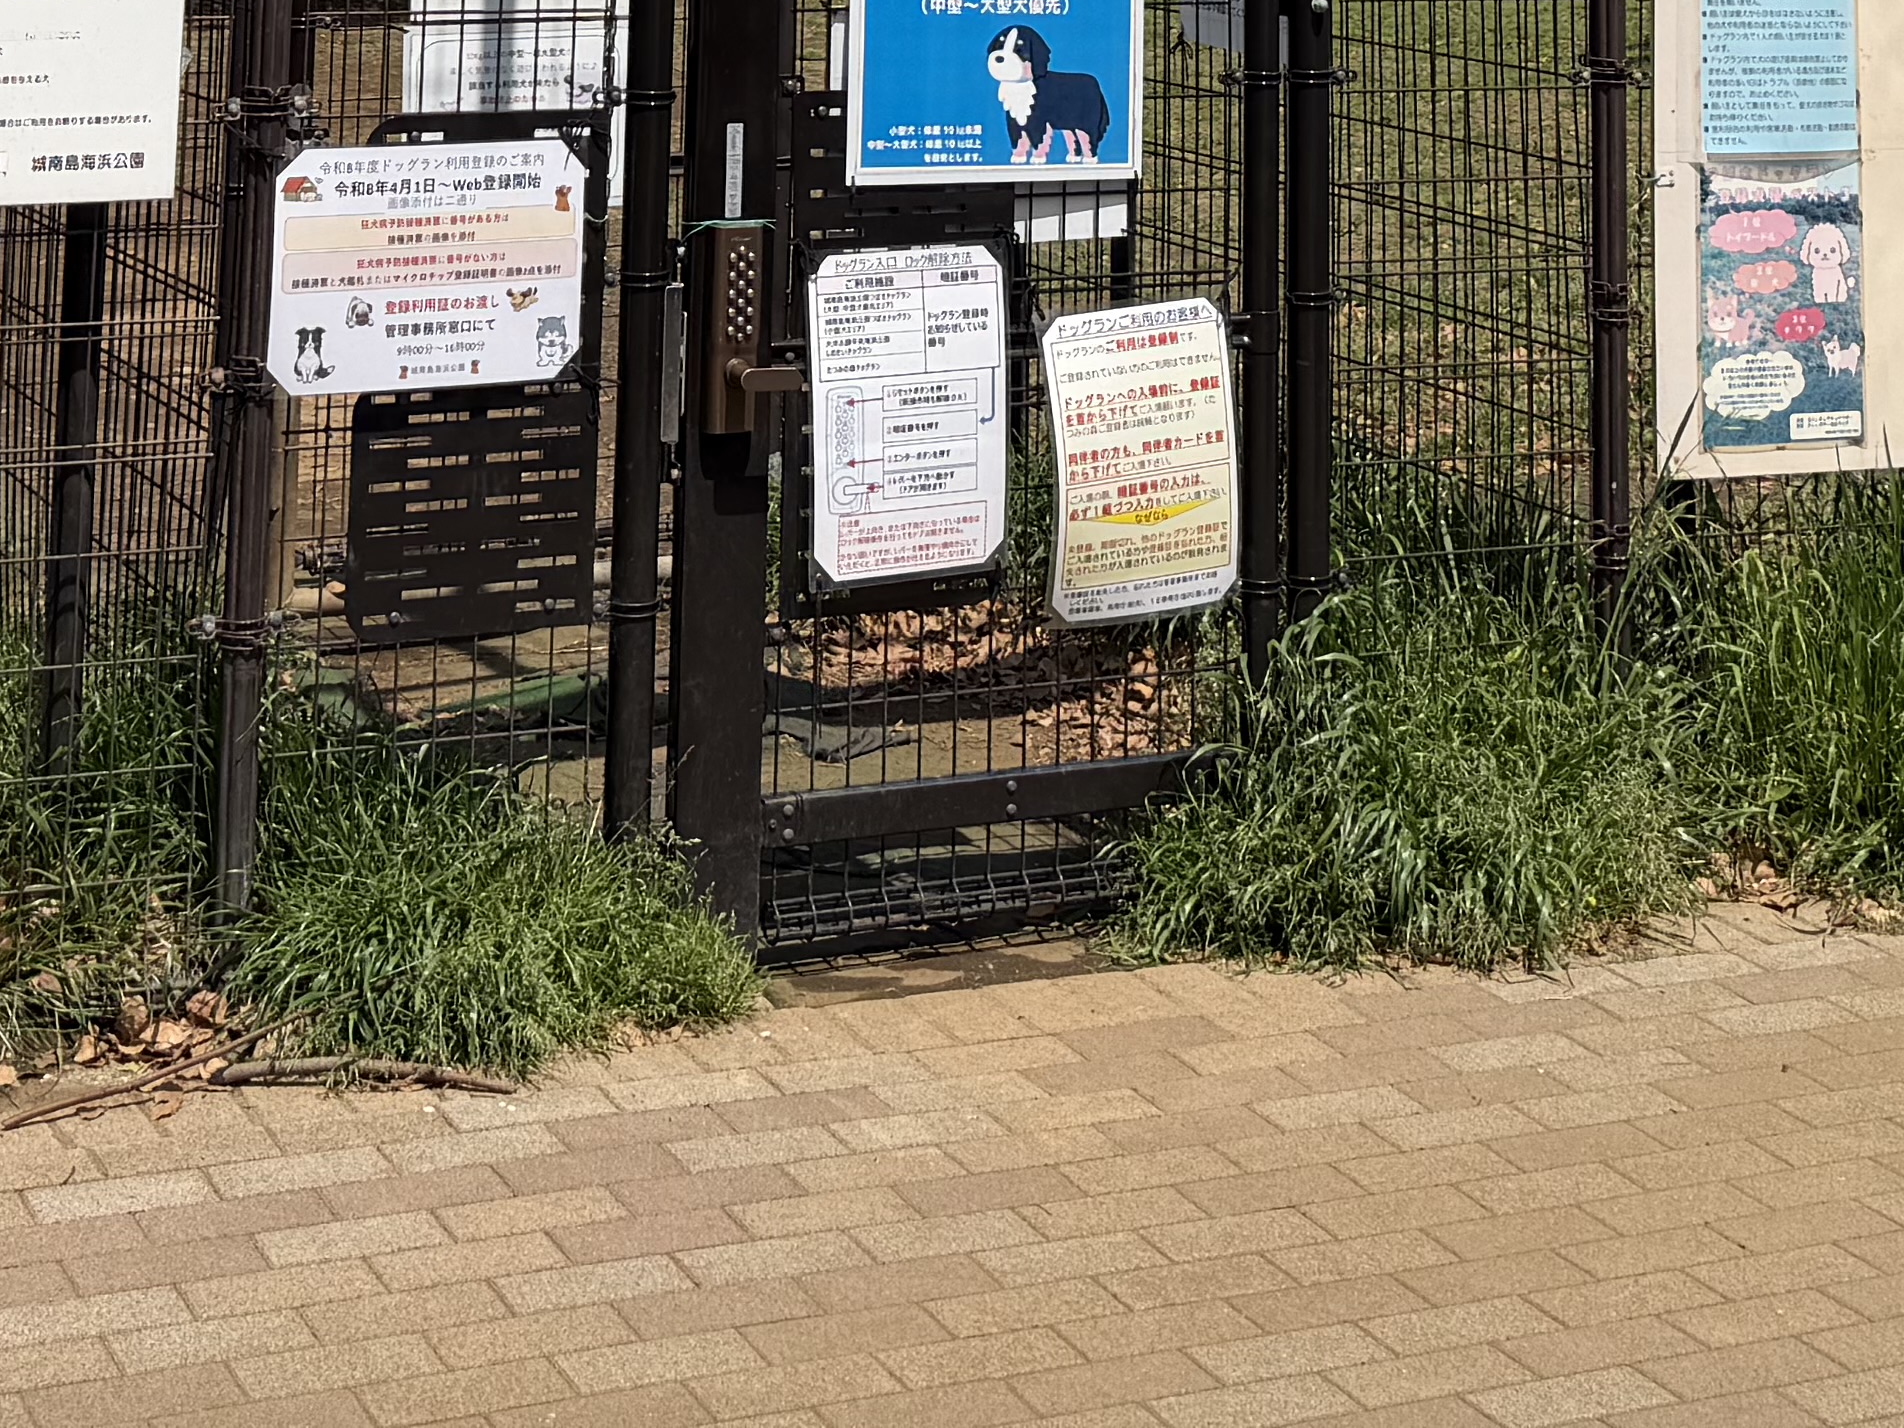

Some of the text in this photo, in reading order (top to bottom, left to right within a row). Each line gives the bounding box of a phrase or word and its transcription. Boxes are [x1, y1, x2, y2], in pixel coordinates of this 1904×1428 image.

[31, 151, 145, 172] 城南島海浜公園
[385, 318, 496, 338] 管理事務所窓口にて
